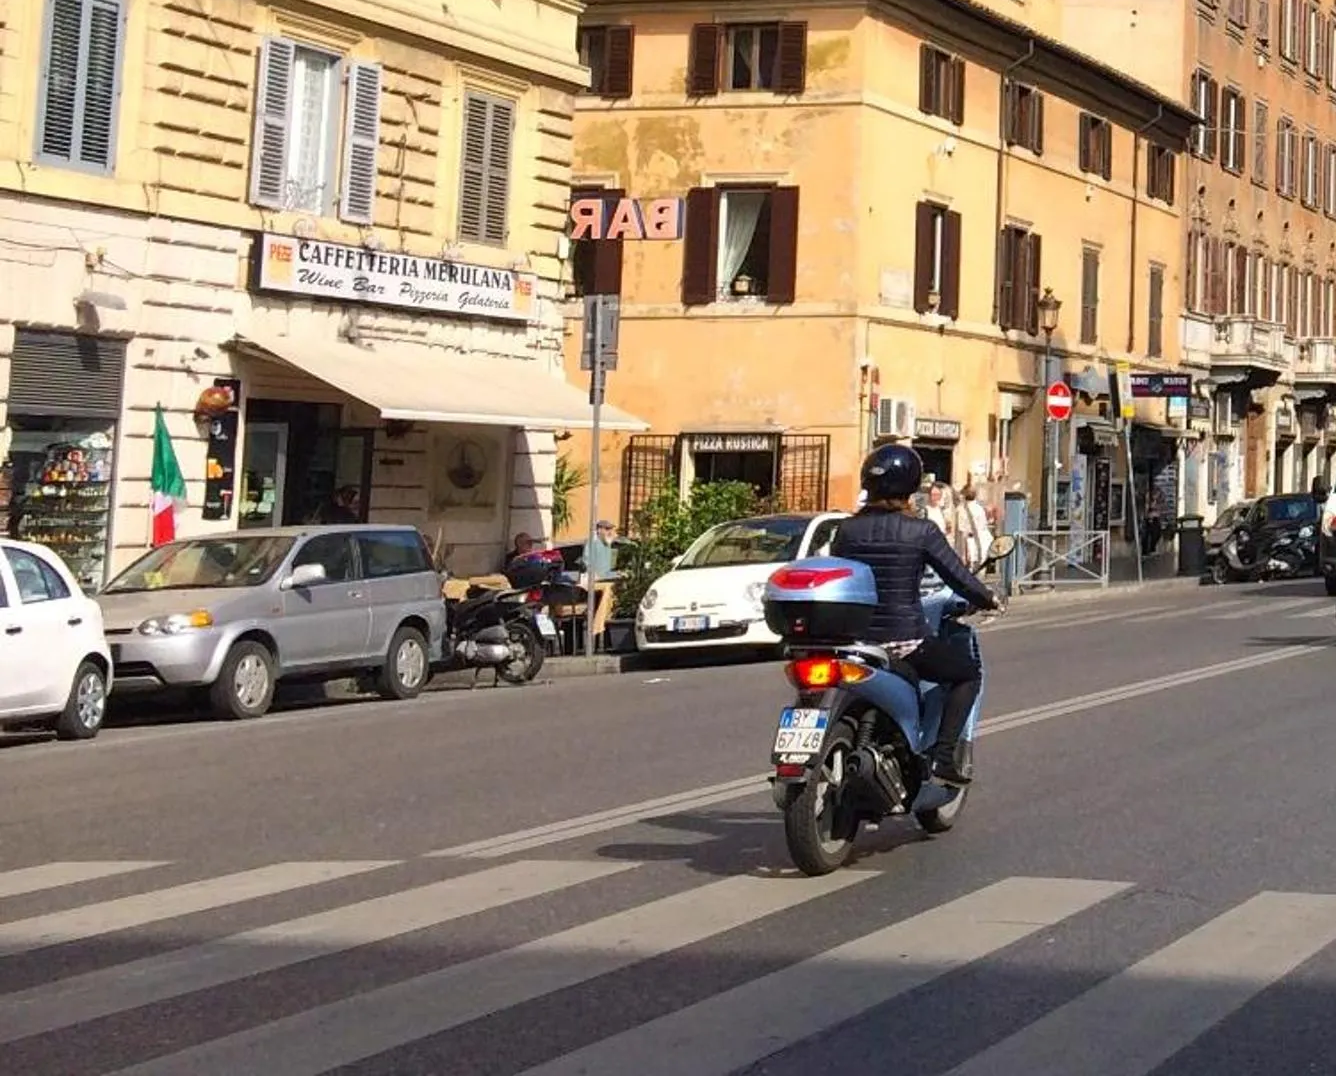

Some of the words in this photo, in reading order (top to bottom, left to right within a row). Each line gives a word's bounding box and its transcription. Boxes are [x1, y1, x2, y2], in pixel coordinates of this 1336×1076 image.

[297, 268, 343, 289] Wine
[352, 276, 385, 294] Bar
[399, 282, 448, 303] Pizzeria
[458, 291, 510, 310] Gelateria
[299, 242, 419, 277] CAFFETTERIA
[424, 261, 512, 291] MERULANA
